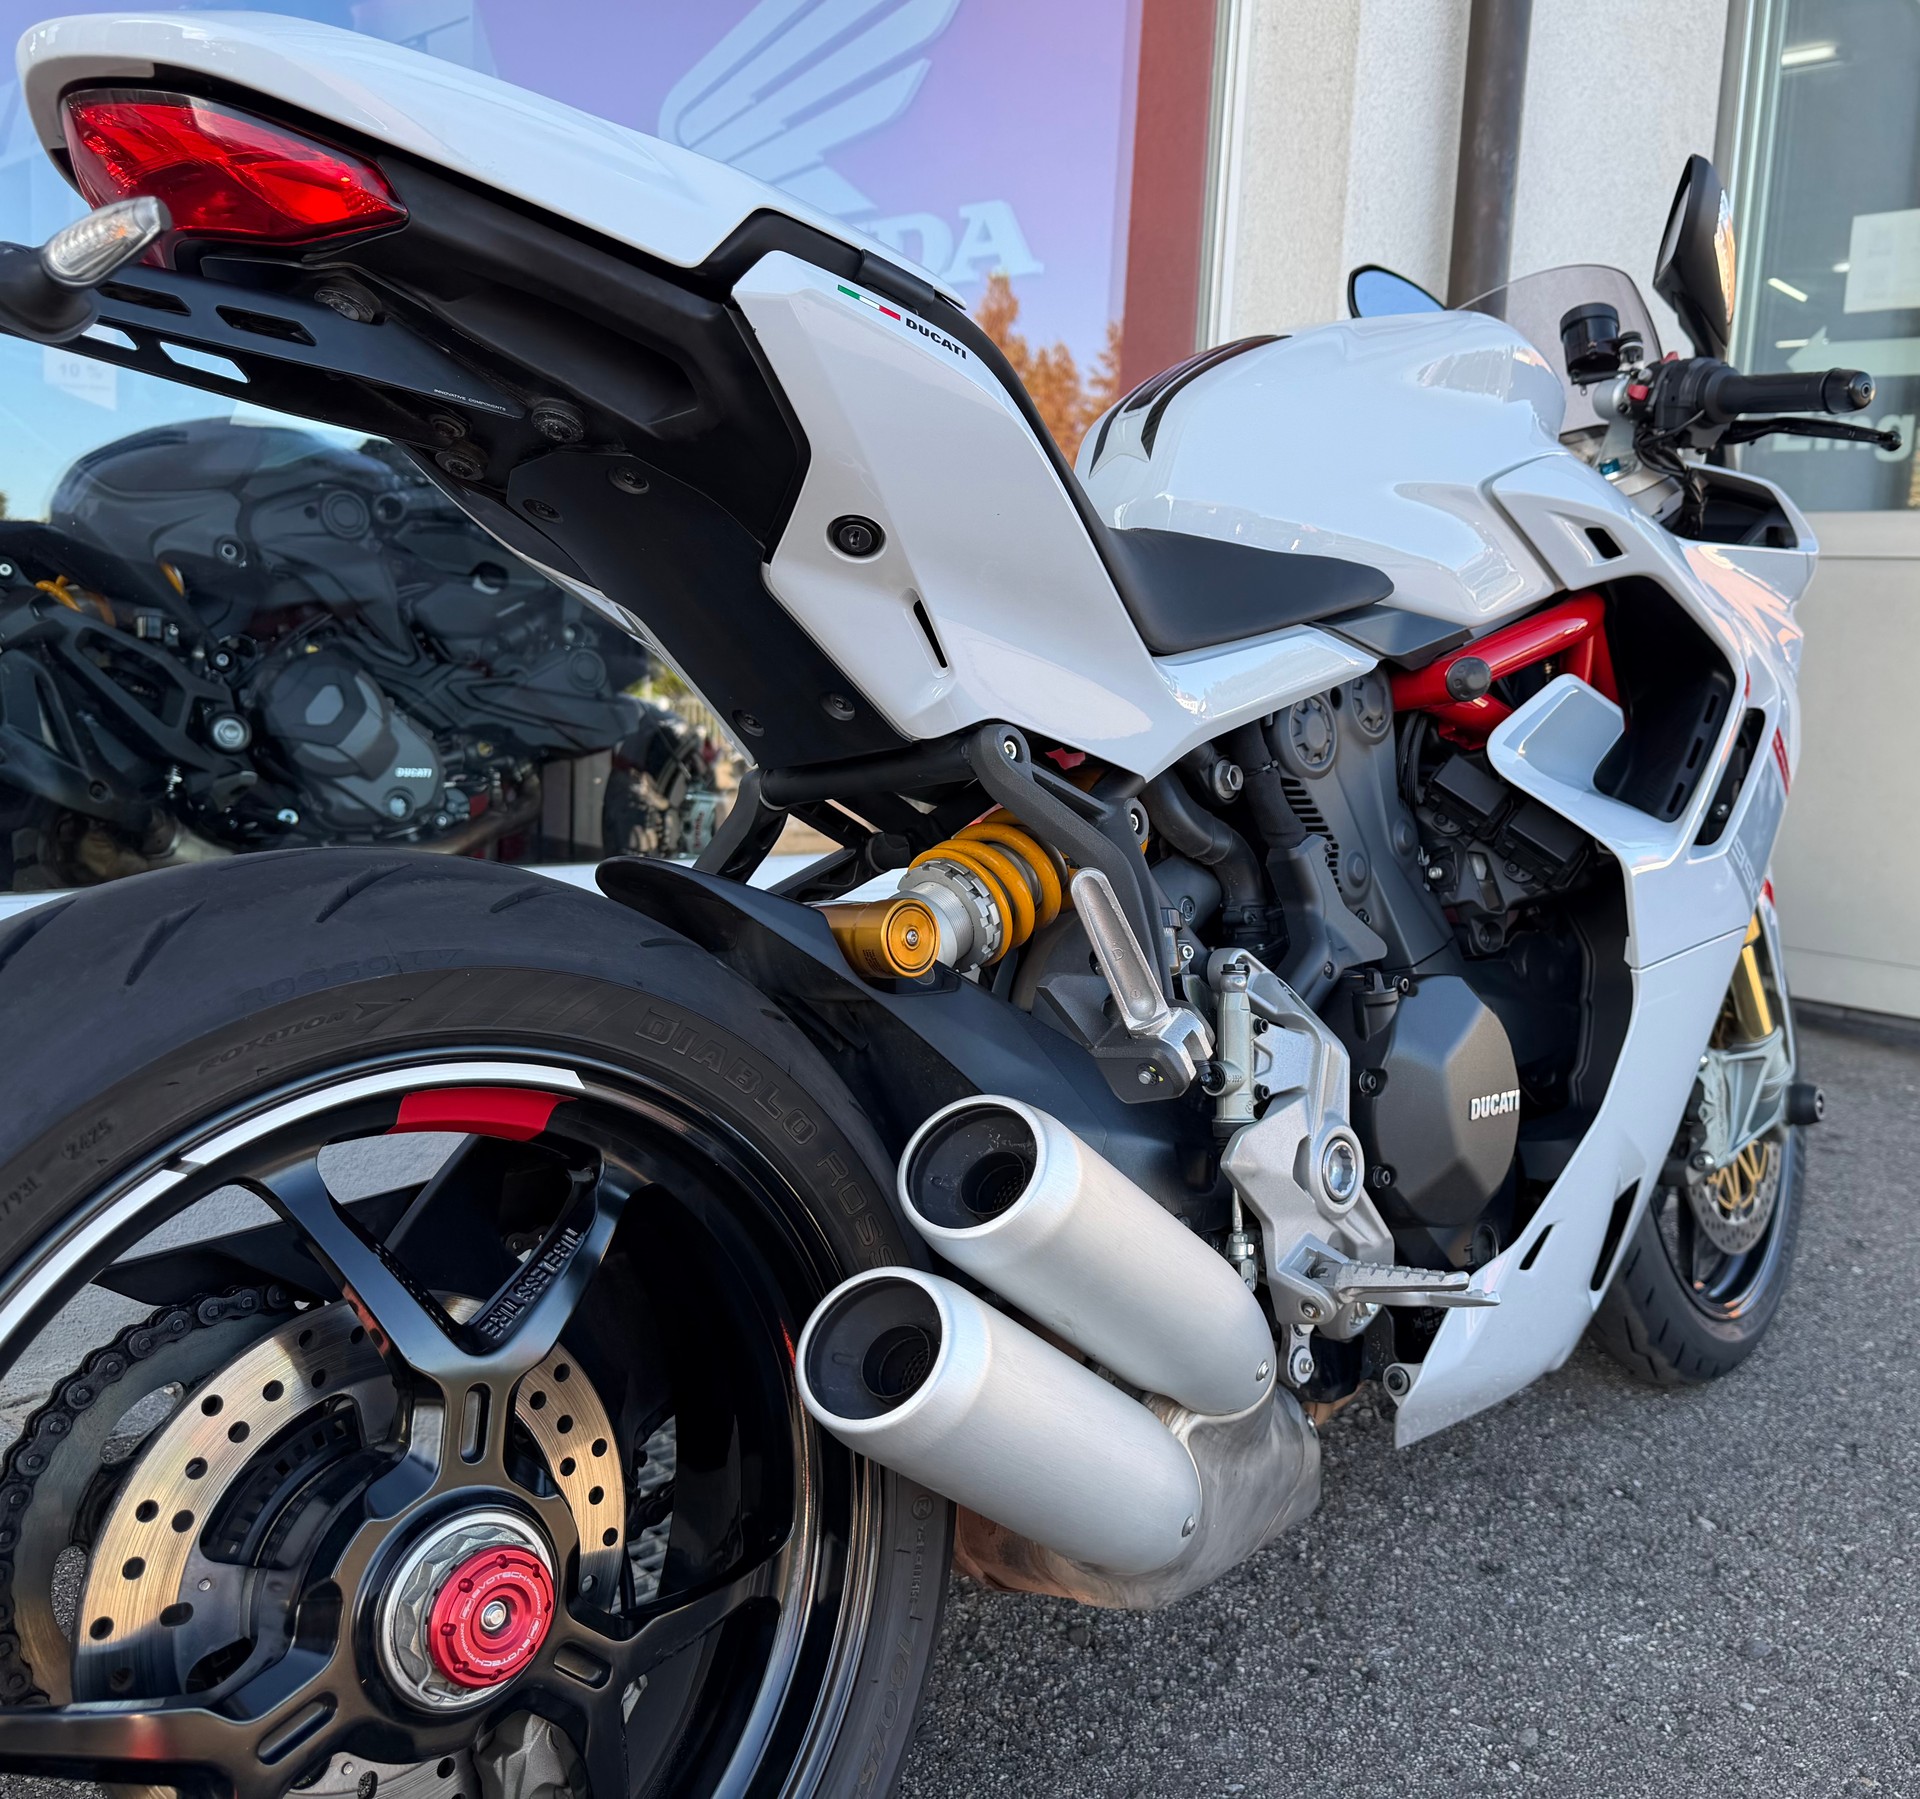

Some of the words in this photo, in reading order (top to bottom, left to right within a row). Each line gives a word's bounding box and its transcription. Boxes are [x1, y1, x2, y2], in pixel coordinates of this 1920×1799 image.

[905, 317, 967, 360] DUCATI
[433, 388, 466, 401] INNOVATIVE
[468, 397, 506, 411] COMPONENTS
[394, 767, 433, 779] DUCATI
[198, 1010, 350, 1076] ROTATION
[1469, 1088, 1520, 1121] DUCATI
[634, 1008, 818, 1145] DIABLO
[816, 1150, 897, 1267] ROSS
[516, 1227, 585, 1302] TUBELESS
[480, 1299, 526, 1340] TIRE
[853, 1631, 914, 1799] 180/5
